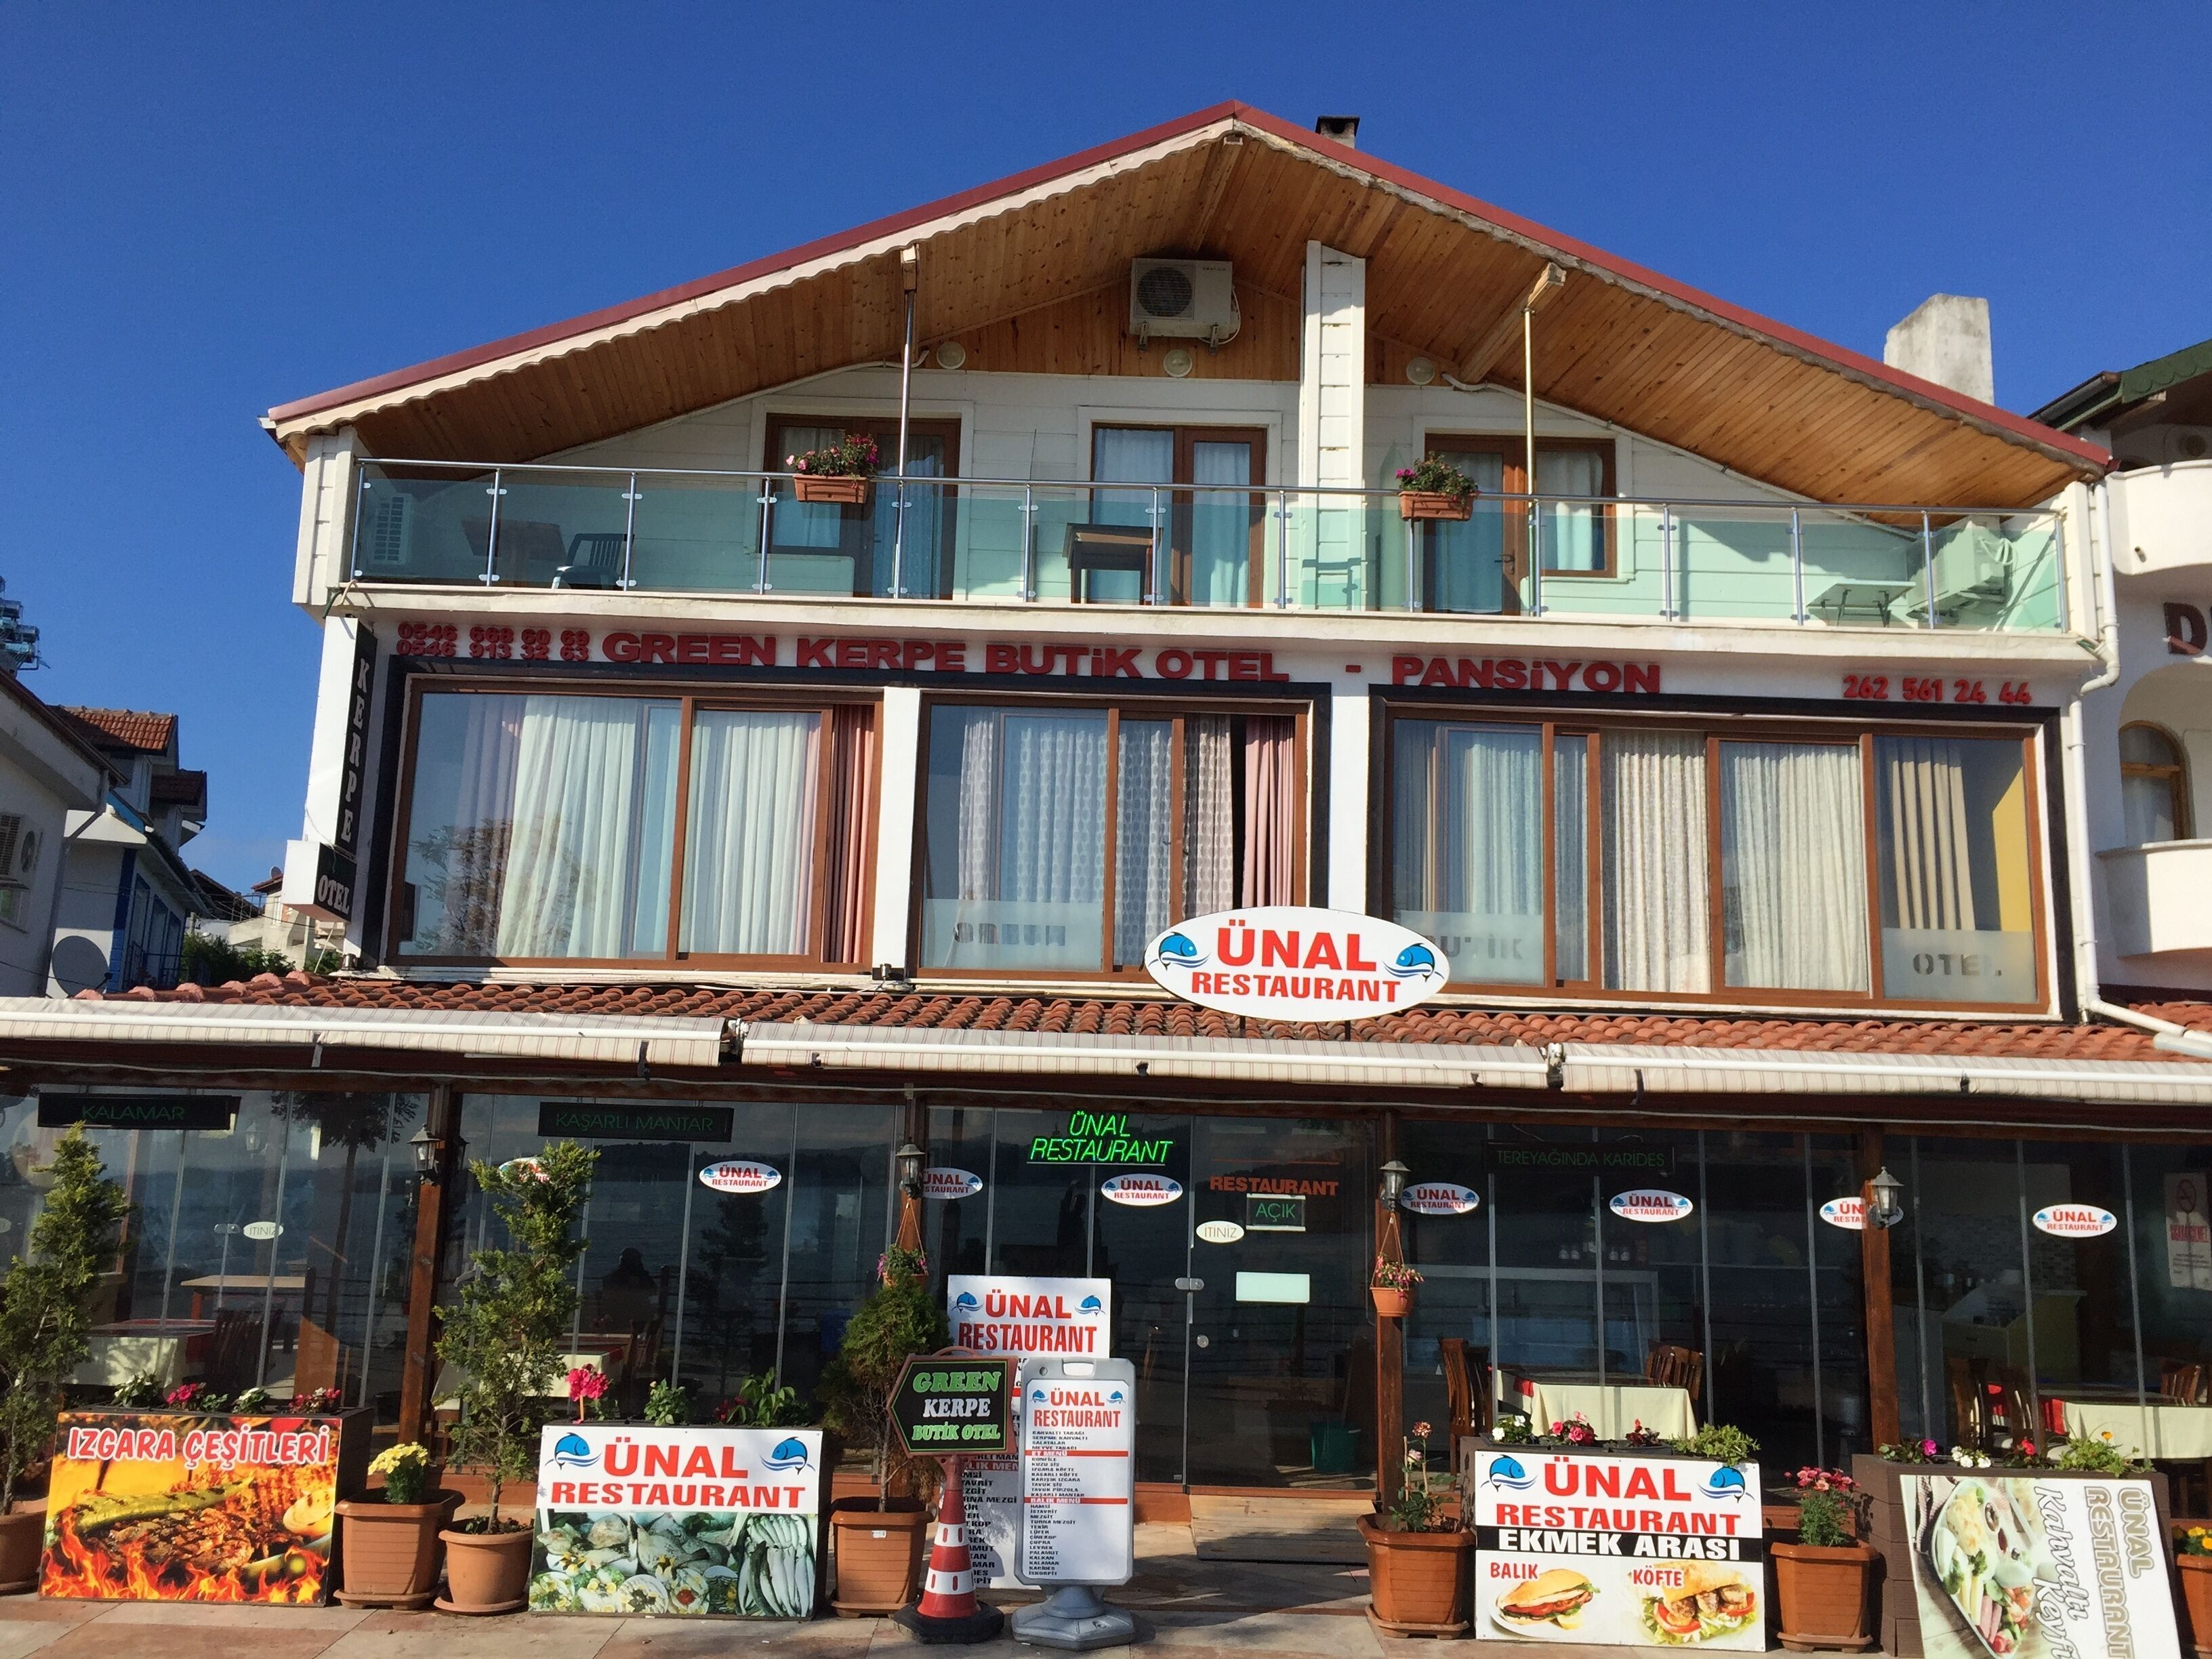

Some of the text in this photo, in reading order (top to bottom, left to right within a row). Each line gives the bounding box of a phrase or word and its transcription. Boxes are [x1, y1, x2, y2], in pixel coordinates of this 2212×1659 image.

[397, 622, 591, 646] 0546 668 60 69
[396, 639, 590, 661] 0546 913 32 63
[602, 632, 777, 666] GREEN
[796, 638, 966, 672] KERPE
[1155, 650, 1290, 682] OTEL
[1843, 675, 2032, 705] 262 561 24 44
[341, 657, 370, 843] KERPE
[317, 874, 350, 915] OTEL
[1217, 919, 1376, 972] ÜNAL
[1191, 971, 1401, 1002] RESTAURANT
[82, 1105, 185, 1120] KALAMAR
[556, 1113, 713, 1131] KAŞARLI MANTAR
[1069, 1110, 1130, 1137] ÜNAL
[1029, 1137, 1174, 1162] RESTAURANT
[1496, 1148, 1664, 1167] TEREYAĞINDA KARİDES
[719, 1164, 762, 1179] ÜNAL
[712, 1179, 769, 1187] RESTAURANT
[1120, 1177, 1164, 1191] ÜNAL
[1209, 1176, 1339, 1197] RESTAURANT
[1416, 1187, 1460, 1200] ÜNAL
[1113, 1191, 1170, 1200] RESTAURANT
[1410, 1201, 1466, 1209] RESTAURANT
[1629, 1193, 1673, 1208] ÜNAL
[1255, 1203, 1296, 1223] AÇIK
[1622, 1208, 1679, 1216] RESTAURANT
[2053, 1208, 2097, 1223] ÜNAL
[1204, 1225, 1237, 1239] İTİNİZ
[2047, 1223, 2104, 1231] RESTAURANT
[985, 1288, 1072, 1319] ÜNAL
[958, 1322, 1097, 1353] RESTAURANT
[913, 1372, 1002, 1393] GREEN
[1050, 1387, 1105, 1406] ÜNAL
[922, 1397, 991, 1418] KERPE
[1033, 1410, 1121, 1428] RESTAURANT
[912, 1421, 960, 1441] BUTİK
[962, 1424, 1001, 1440] OTEL
[68, 1424, 331, 1469] IZGARA ÇEŞİTLERİ
[604, 1436, 749, 1479] ÜNAL
[1544, 1456, 1692, 1502] ÜNAL
[551, 1482, 806, 1508] RESTAURANT
[1496, 1503, 1741, 1535] RESTAURANT
[2117, 1487, 2156, 1579] ÜNAL
[1498, 1529, 1740, 1561] EKMEK ARASI
[1490, 1561, 1538, 1580] BALIK
[1633, 1565, 1683, 1587] KÖFTE
[2085, 1486, 2135, 1659] RESTAURANT
